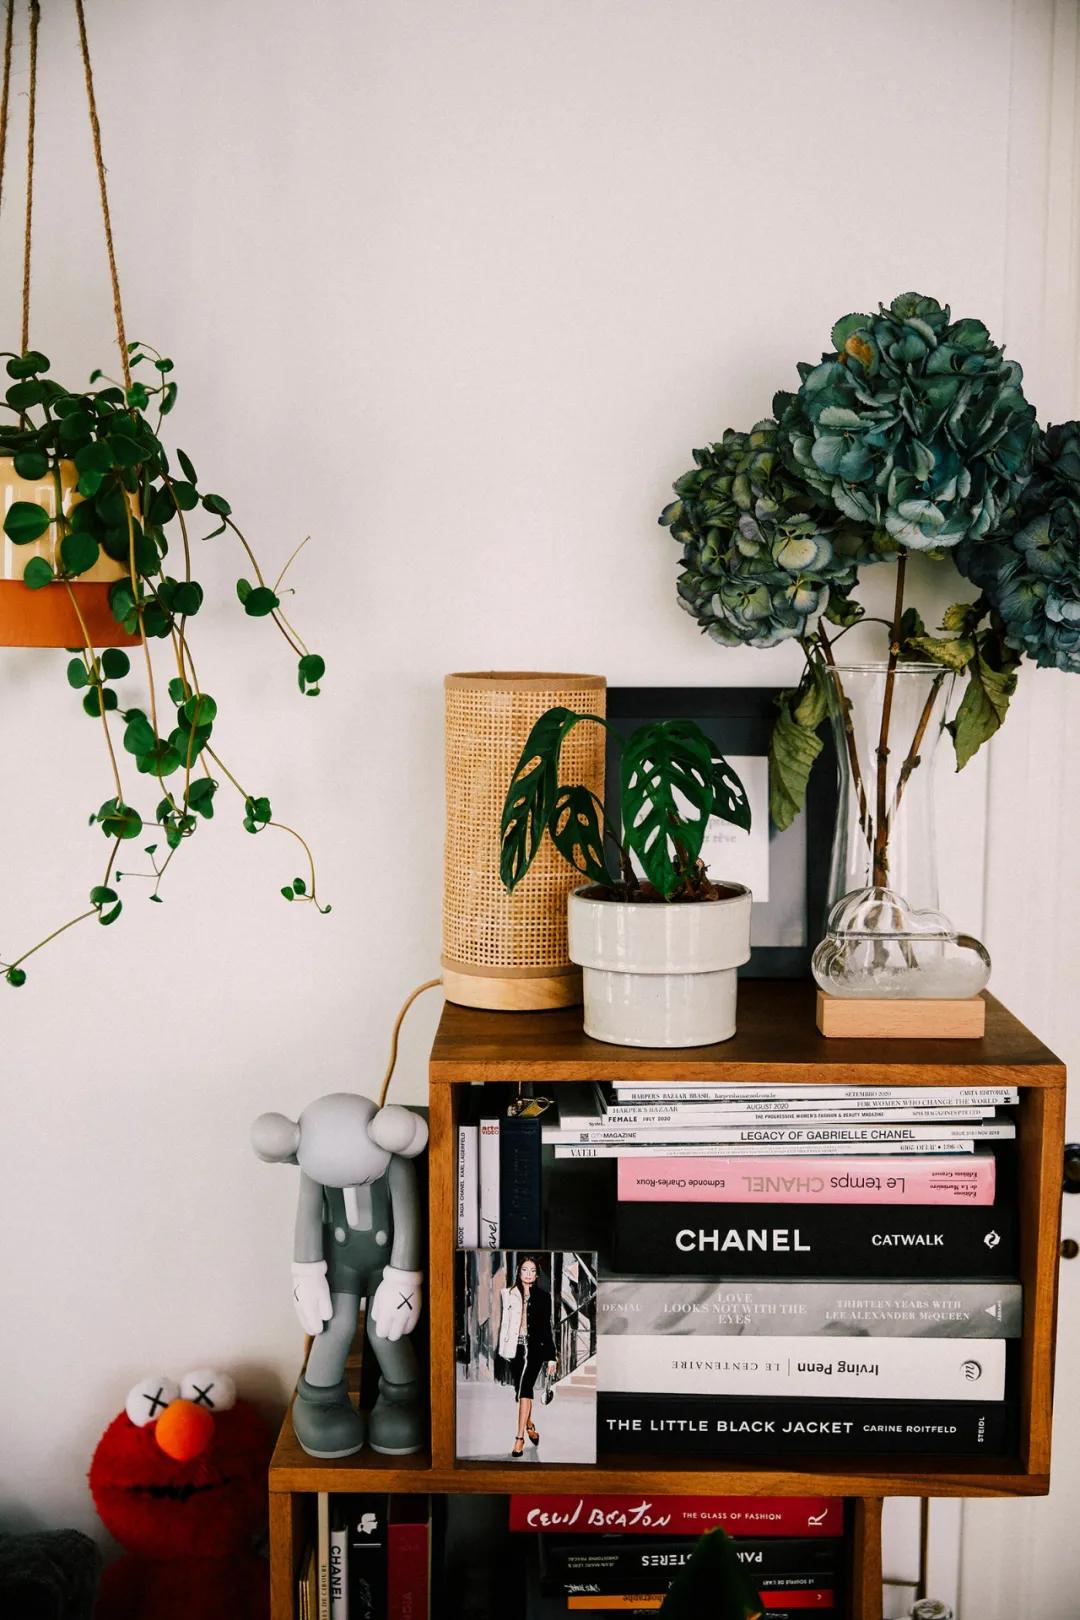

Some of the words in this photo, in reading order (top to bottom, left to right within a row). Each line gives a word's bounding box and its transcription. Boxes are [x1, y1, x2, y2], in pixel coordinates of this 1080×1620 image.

[740, 1131, 785, 1141] LEGACY
[788, 1131, 803, 1140] OF
[806, 1130, 867, 1140] GABRIELLE
[870, 1130, 915, 1139] CHANEL
[636, 1178, 687, 1187] Charles-Roux
[688, 1179, 725, 1187] Edmonde
[742, 1176, 825, 1193] CHANEL
[830, 1173, 882, 1190] temps
[886, 1177, 905, 1193] Le
[675, 1229, 811, 1251] CHANEL
[872, 1234, 944, 1246] CATWALK
[717, 1294, 753, 1303] LOVE
[664, 1304, 709, 1313] LOOKS
[712, 1304, 739, 1314] NOT
[741, 1304, 777, 1314] WITH
[779, 1304, 807, 1315] THE
[836, 1300, 891, 1309] THIRTEEN
[893, 1300, 930, 1309] YEARS
[932, 1301, 962, 1309] WITH
[718, 1314, 752, 1324] EYES
[825, 1311, 847, 1320] LEE
[850, 1311, 916, 1320] ALEXANDER
[919, 1311, 970, 1321] McQUEEN
[672, 1361, 758, 1371] CENTENAIRE
[765, 1363, 781, 1372] LE
[797, 1363, 832, 1375] Penn
[837, 1361, 879, 1376] Irving
[606, 1419, 642, 1431] THE
[650, 1420, 708, 1432] LITTLE
[717, 1421, 776, 1433] BLACK
[782, 1421, 853, 1434] JACKET
[906, 1425, 957, 1433] ROITFELD
[331, 1545, 342, 1602] CHANEL
